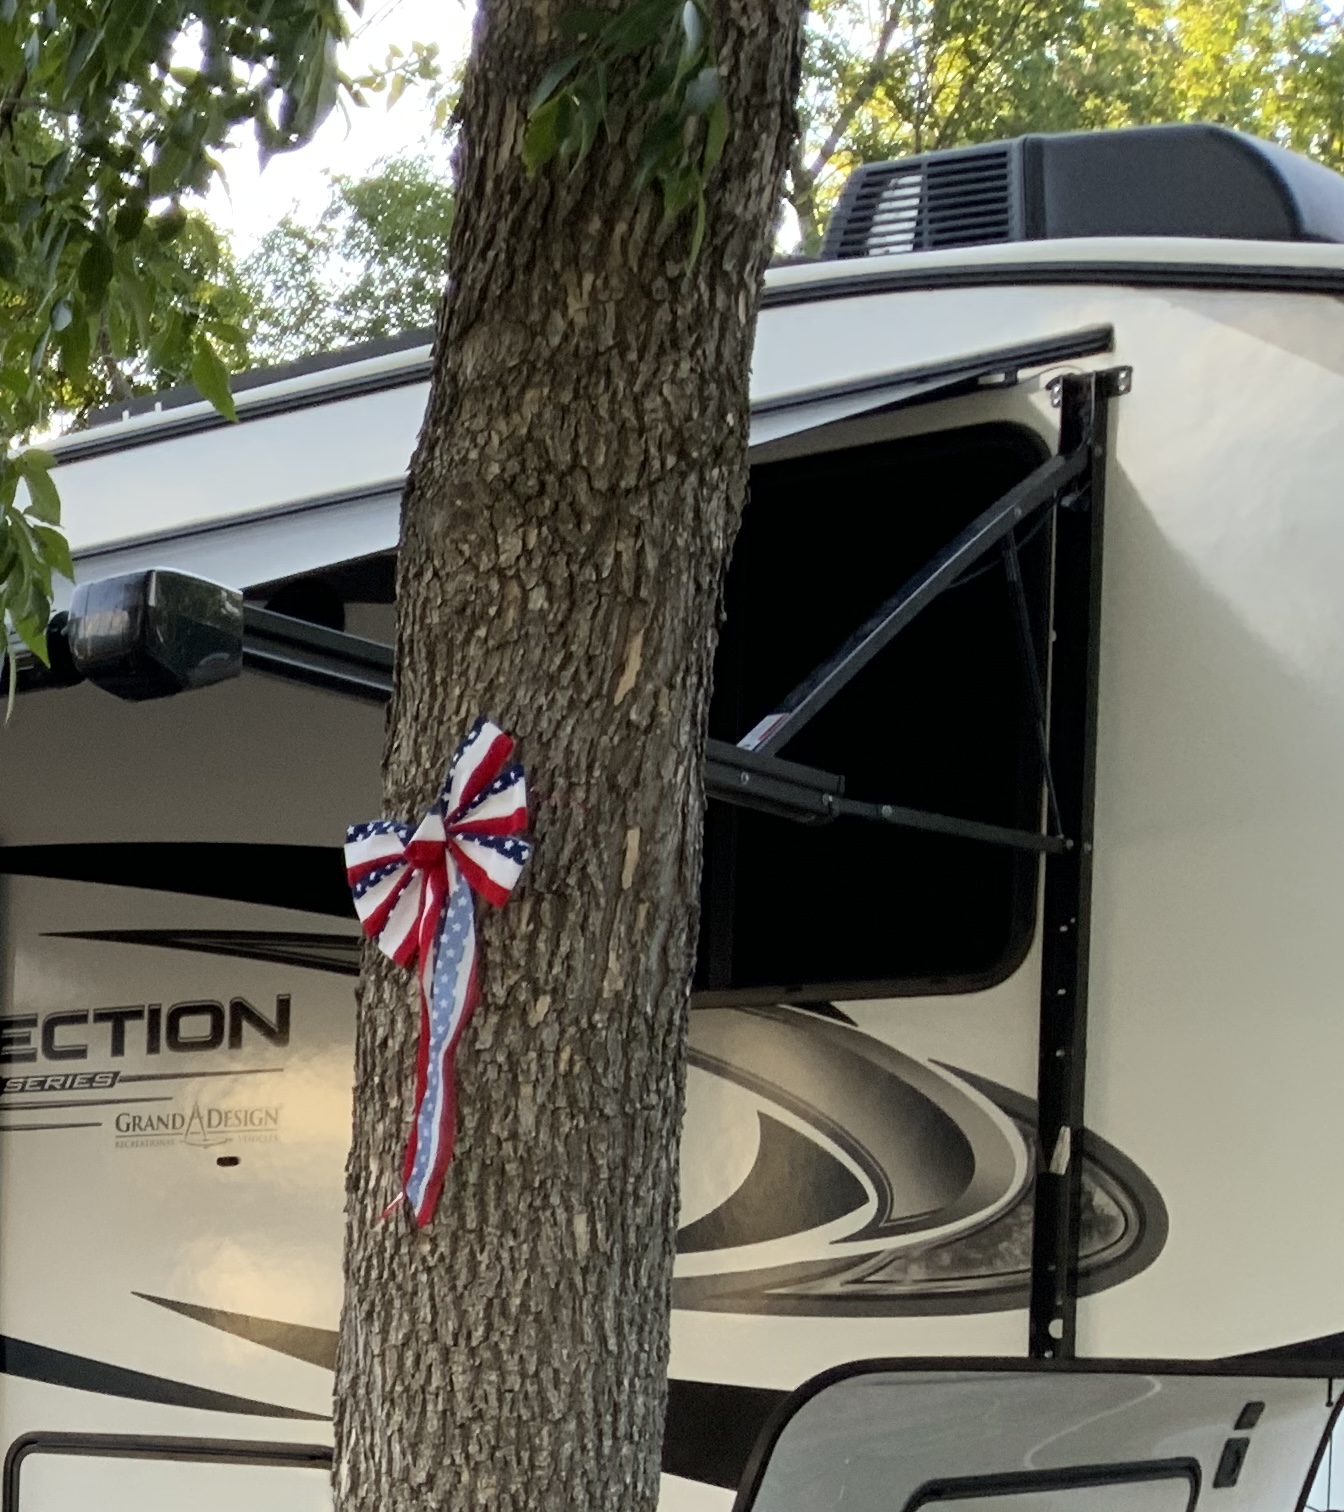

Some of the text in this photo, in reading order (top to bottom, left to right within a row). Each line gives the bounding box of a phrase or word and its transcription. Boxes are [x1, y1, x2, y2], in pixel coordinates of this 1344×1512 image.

[4, 1073, 115, 1092] SERIES
[115, 1107, 279, 1133] GRAND DESIGN
